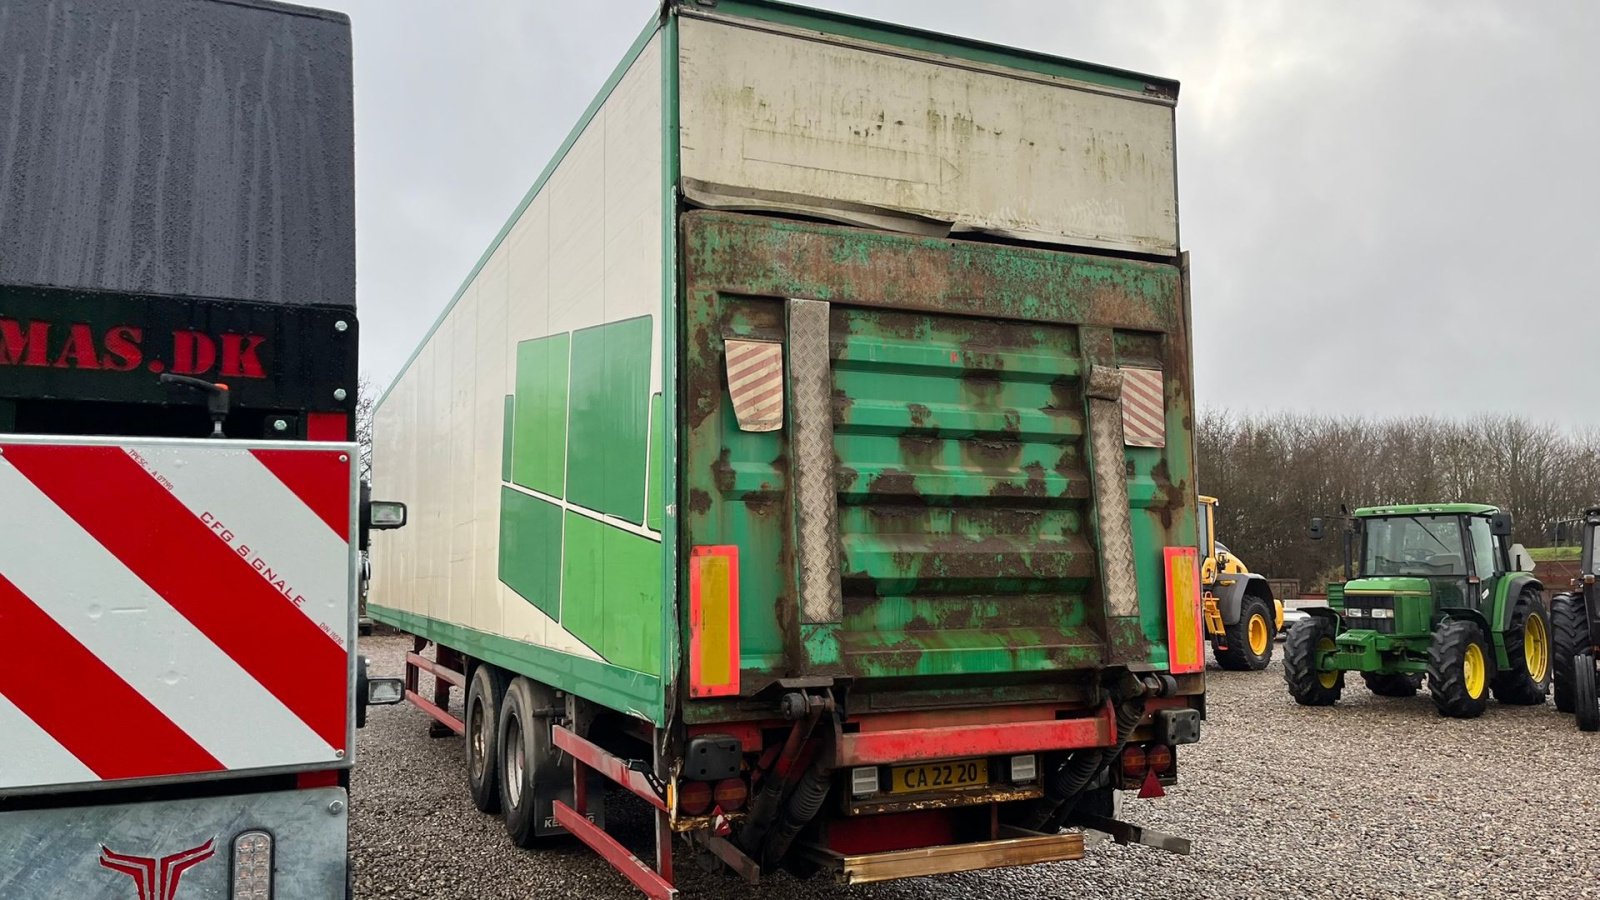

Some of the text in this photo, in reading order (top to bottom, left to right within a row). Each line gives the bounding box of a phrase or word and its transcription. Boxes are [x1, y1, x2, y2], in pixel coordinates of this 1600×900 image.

[200, 511, 306, 608] CFG SGNALE
[319, 621, 331, 634] DIN
[904, 763, 978, 788] CA 22 20
